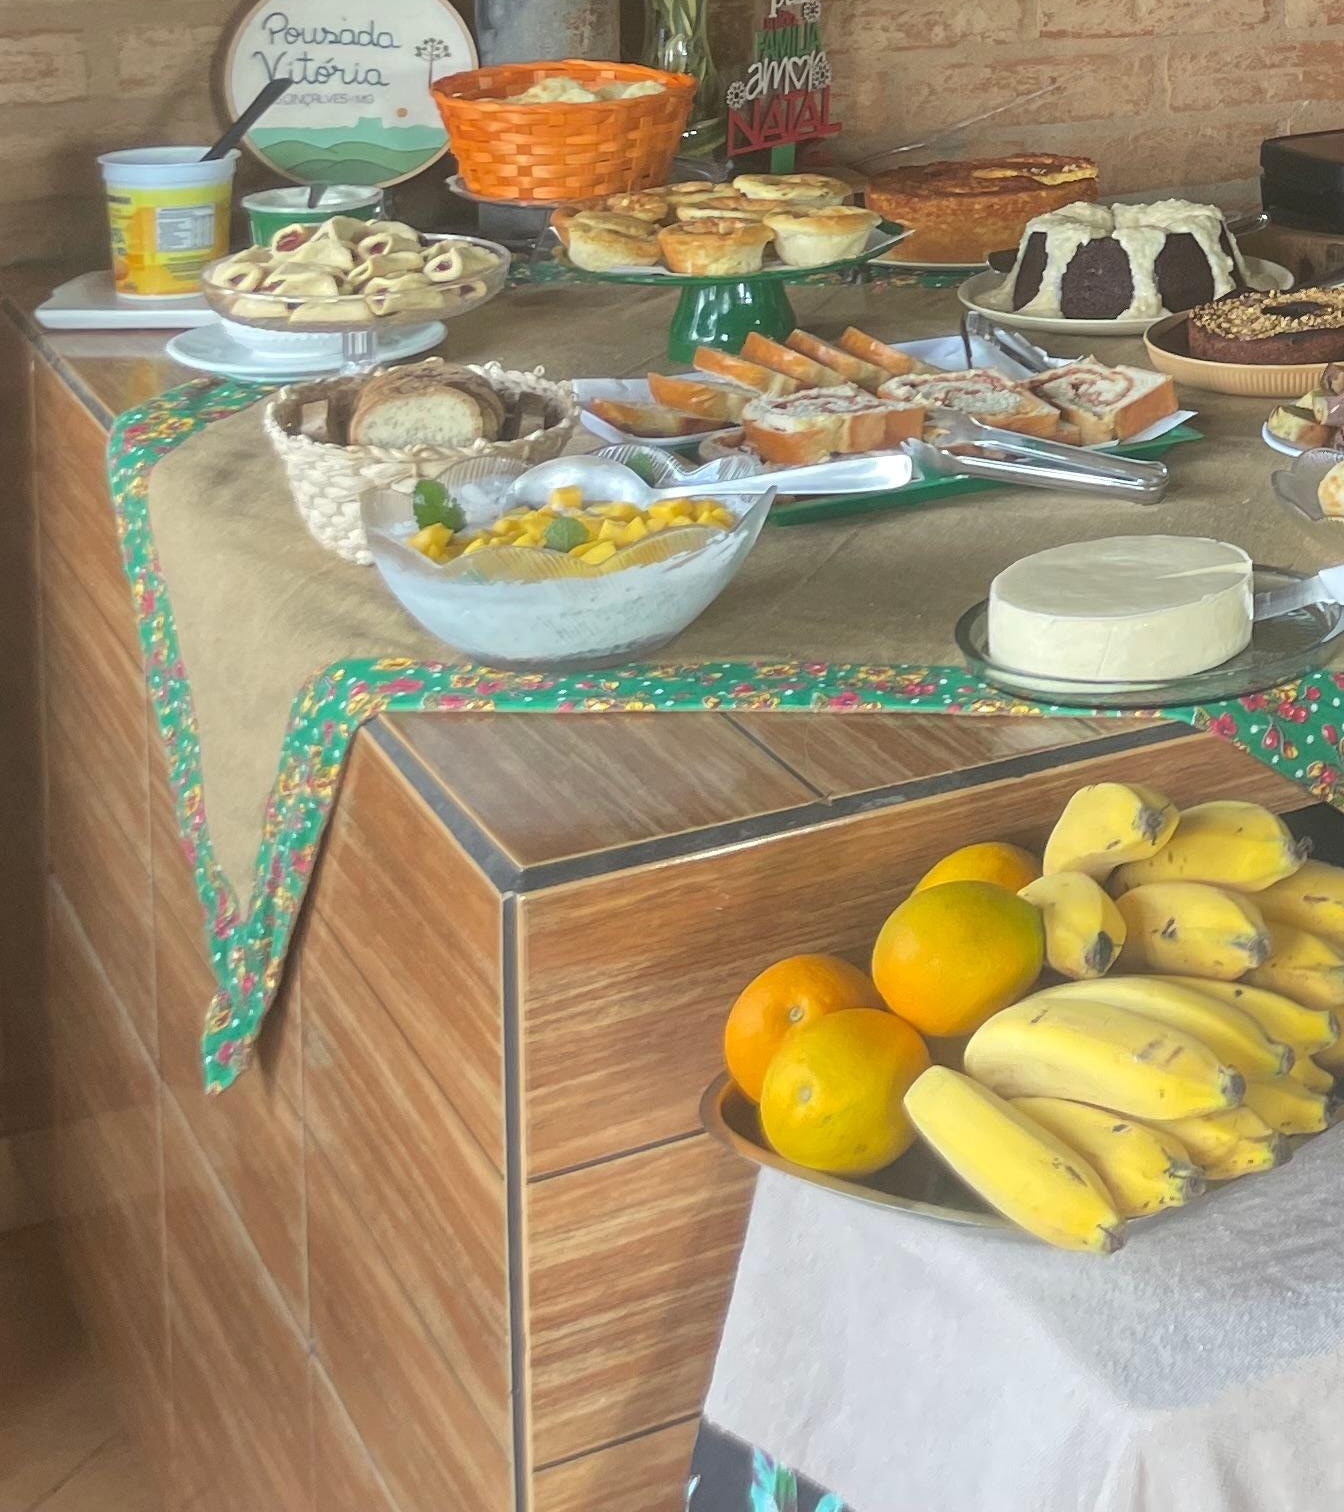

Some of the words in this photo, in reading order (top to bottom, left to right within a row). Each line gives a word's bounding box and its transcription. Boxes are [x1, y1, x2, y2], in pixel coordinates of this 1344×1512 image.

[262, 12, 401, 48] Pousada
[253, 51, 390, 86] Vitória
[726, 84, 842, 157] NATAL
